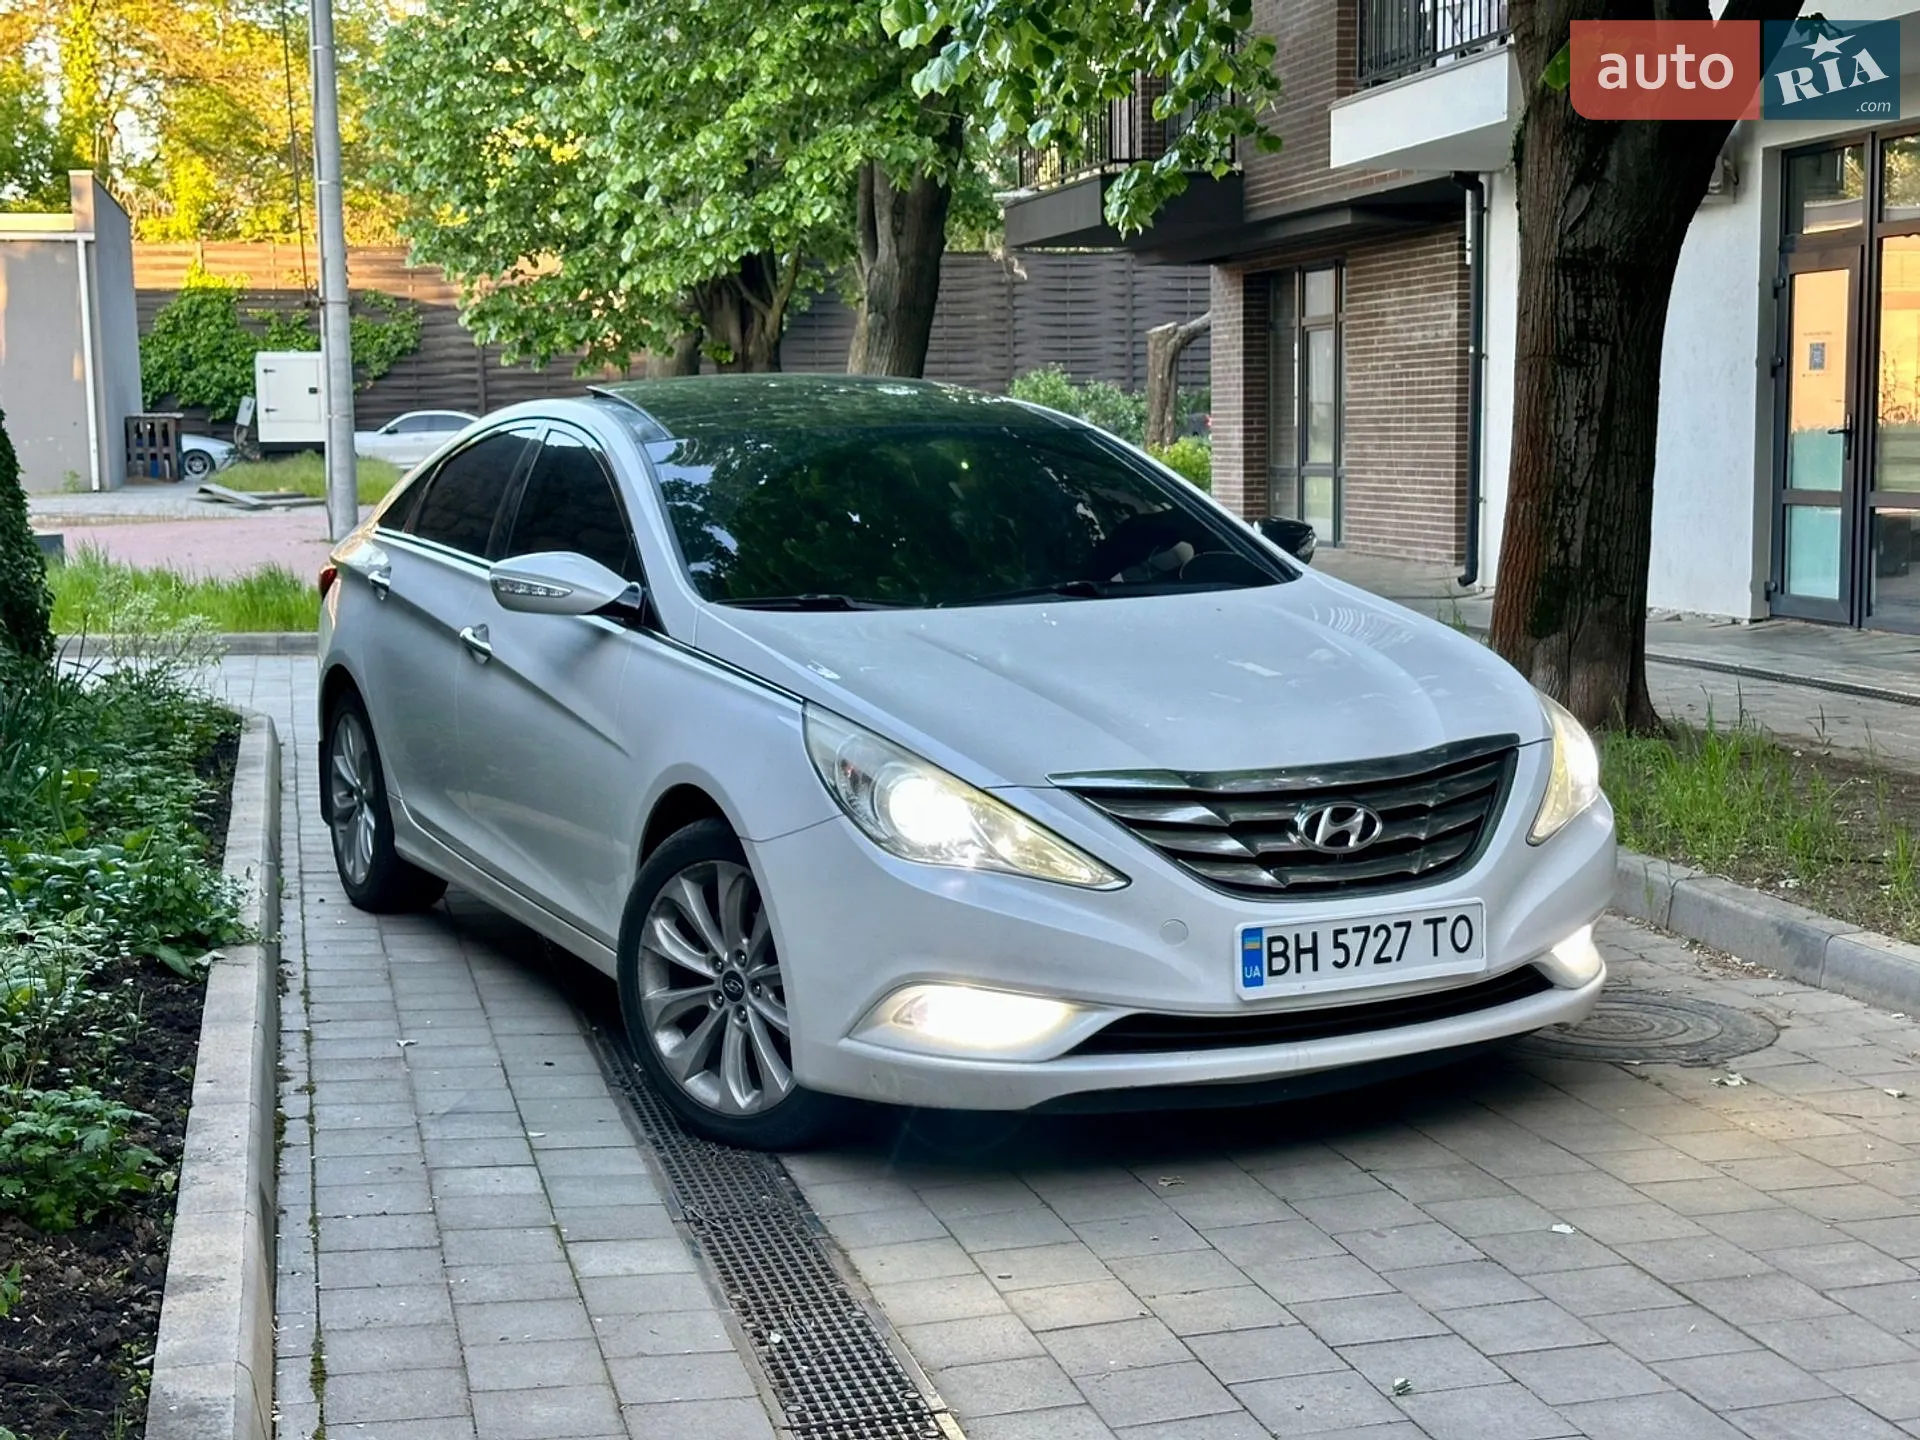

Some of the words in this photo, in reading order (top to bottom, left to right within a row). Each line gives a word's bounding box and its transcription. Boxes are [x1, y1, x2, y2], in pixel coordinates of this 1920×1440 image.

[1267, 931, 1318, 977] BH
[1332, 920, 1412, 969] 5727
[1423, 914, 1473, 957] TO
[1244, 966, 1261, 979] UA
